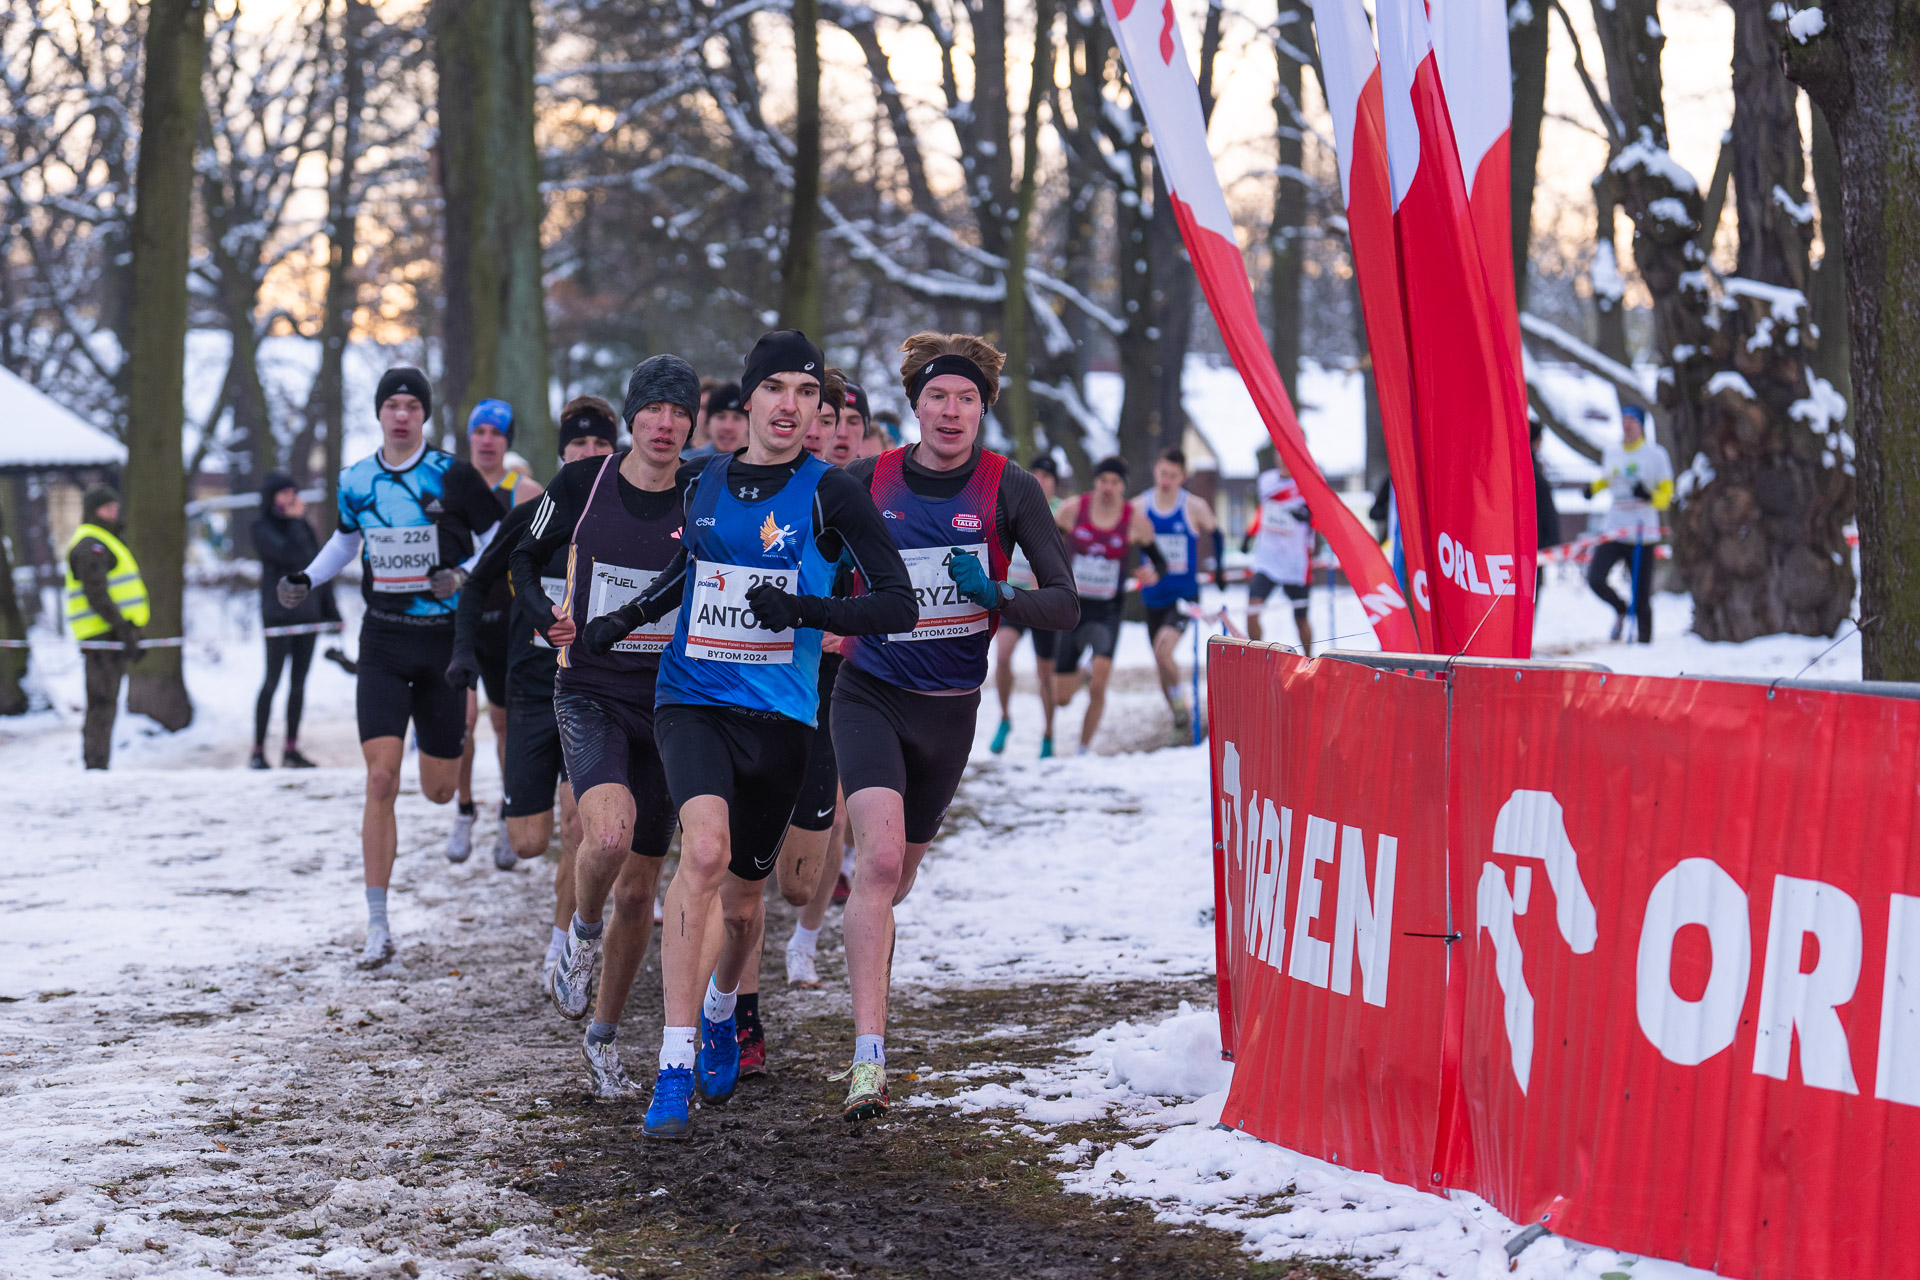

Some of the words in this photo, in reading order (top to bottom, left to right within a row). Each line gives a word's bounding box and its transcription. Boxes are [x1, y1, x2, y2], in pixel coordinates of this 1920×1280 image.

[696, 517, 716, 527] esa
[957, 519, 979, 528] TALEX
[403, 530, 431, 544] 226
[372, 552, 436, 570] BAJORSKI
[1438, 531, 1516, 596] ORLE
[607, 575, 638, 589] FUEL
[697, 579, 719, 589] polanik
[697, 603, 759, 630] ANTO
[912, 629, 945, 638] BYTOM
[947, 626, 970, 635] 2024
[707, 650, 741, 660] BYTOM
[744, 653, 768, 662] 2024
[1244, 789, 1398, 1008] ORLEN
